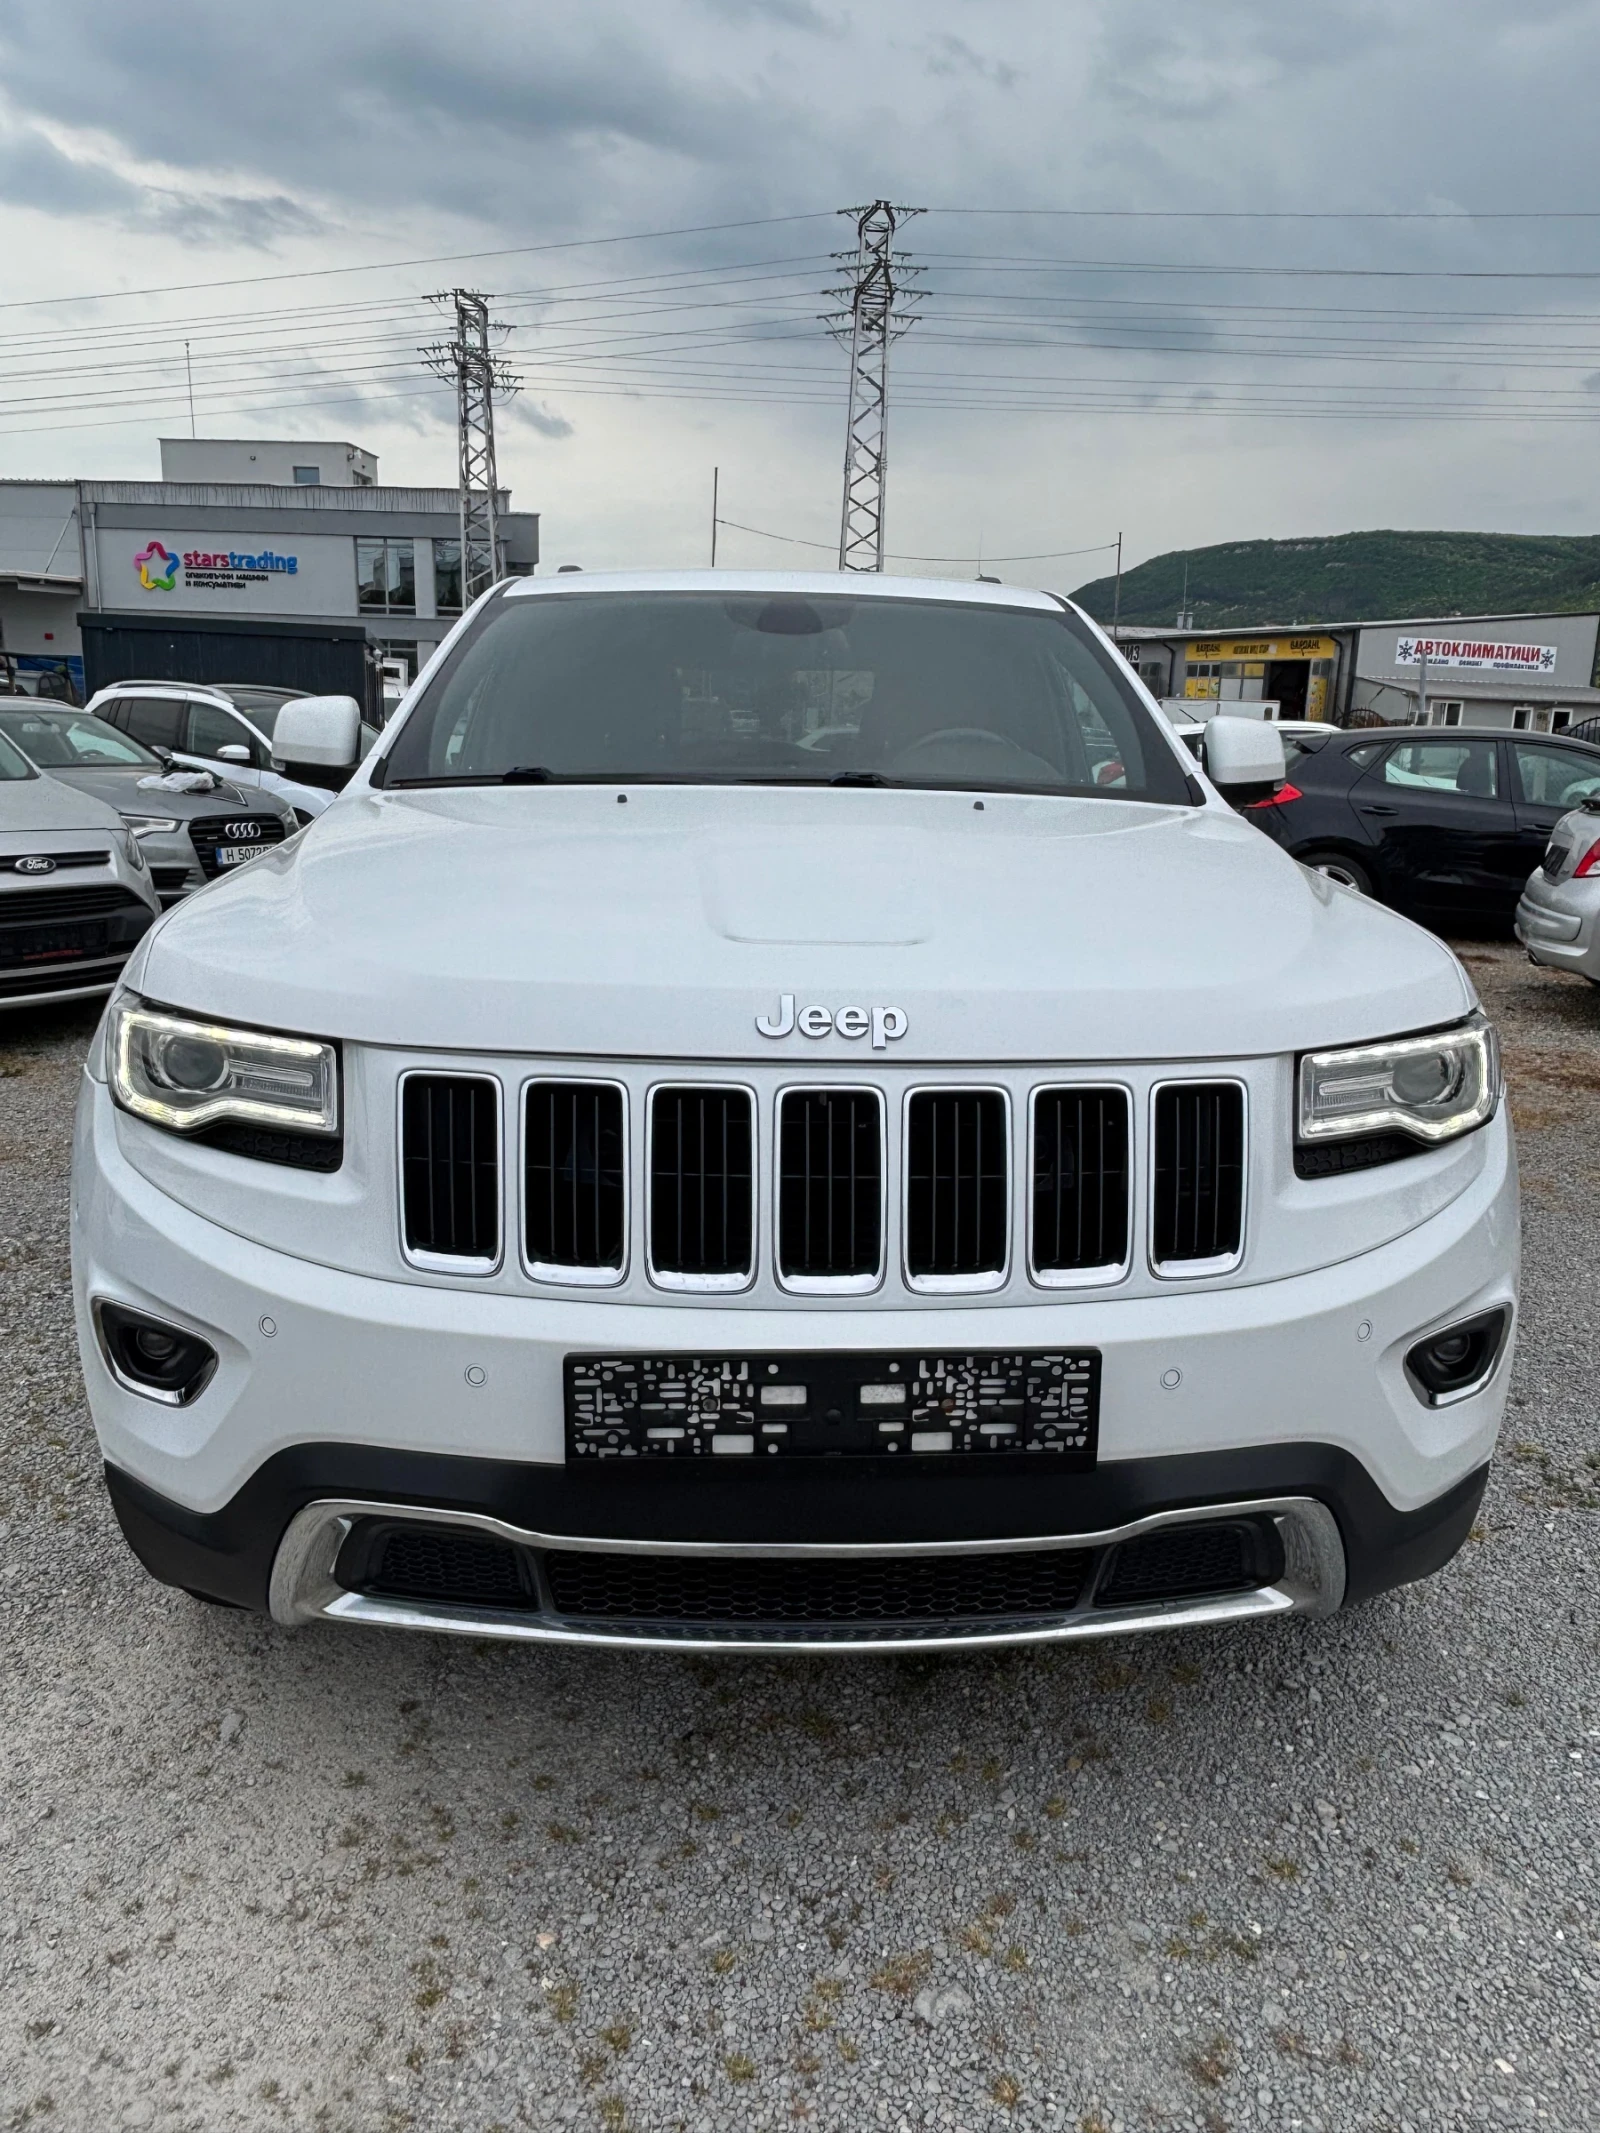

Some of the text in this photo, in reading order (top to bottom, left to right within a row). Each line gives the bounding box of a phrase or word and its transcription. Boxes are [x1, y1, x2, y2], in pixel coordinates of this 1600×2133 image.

[183, 550, 298, 575] starstrading
[1414, 640, 1541, 663] АВТОКЛИМАТИЦИ
[26, 859, 49, 869] Ford
[755, 994, 909, 1050] Jeep
